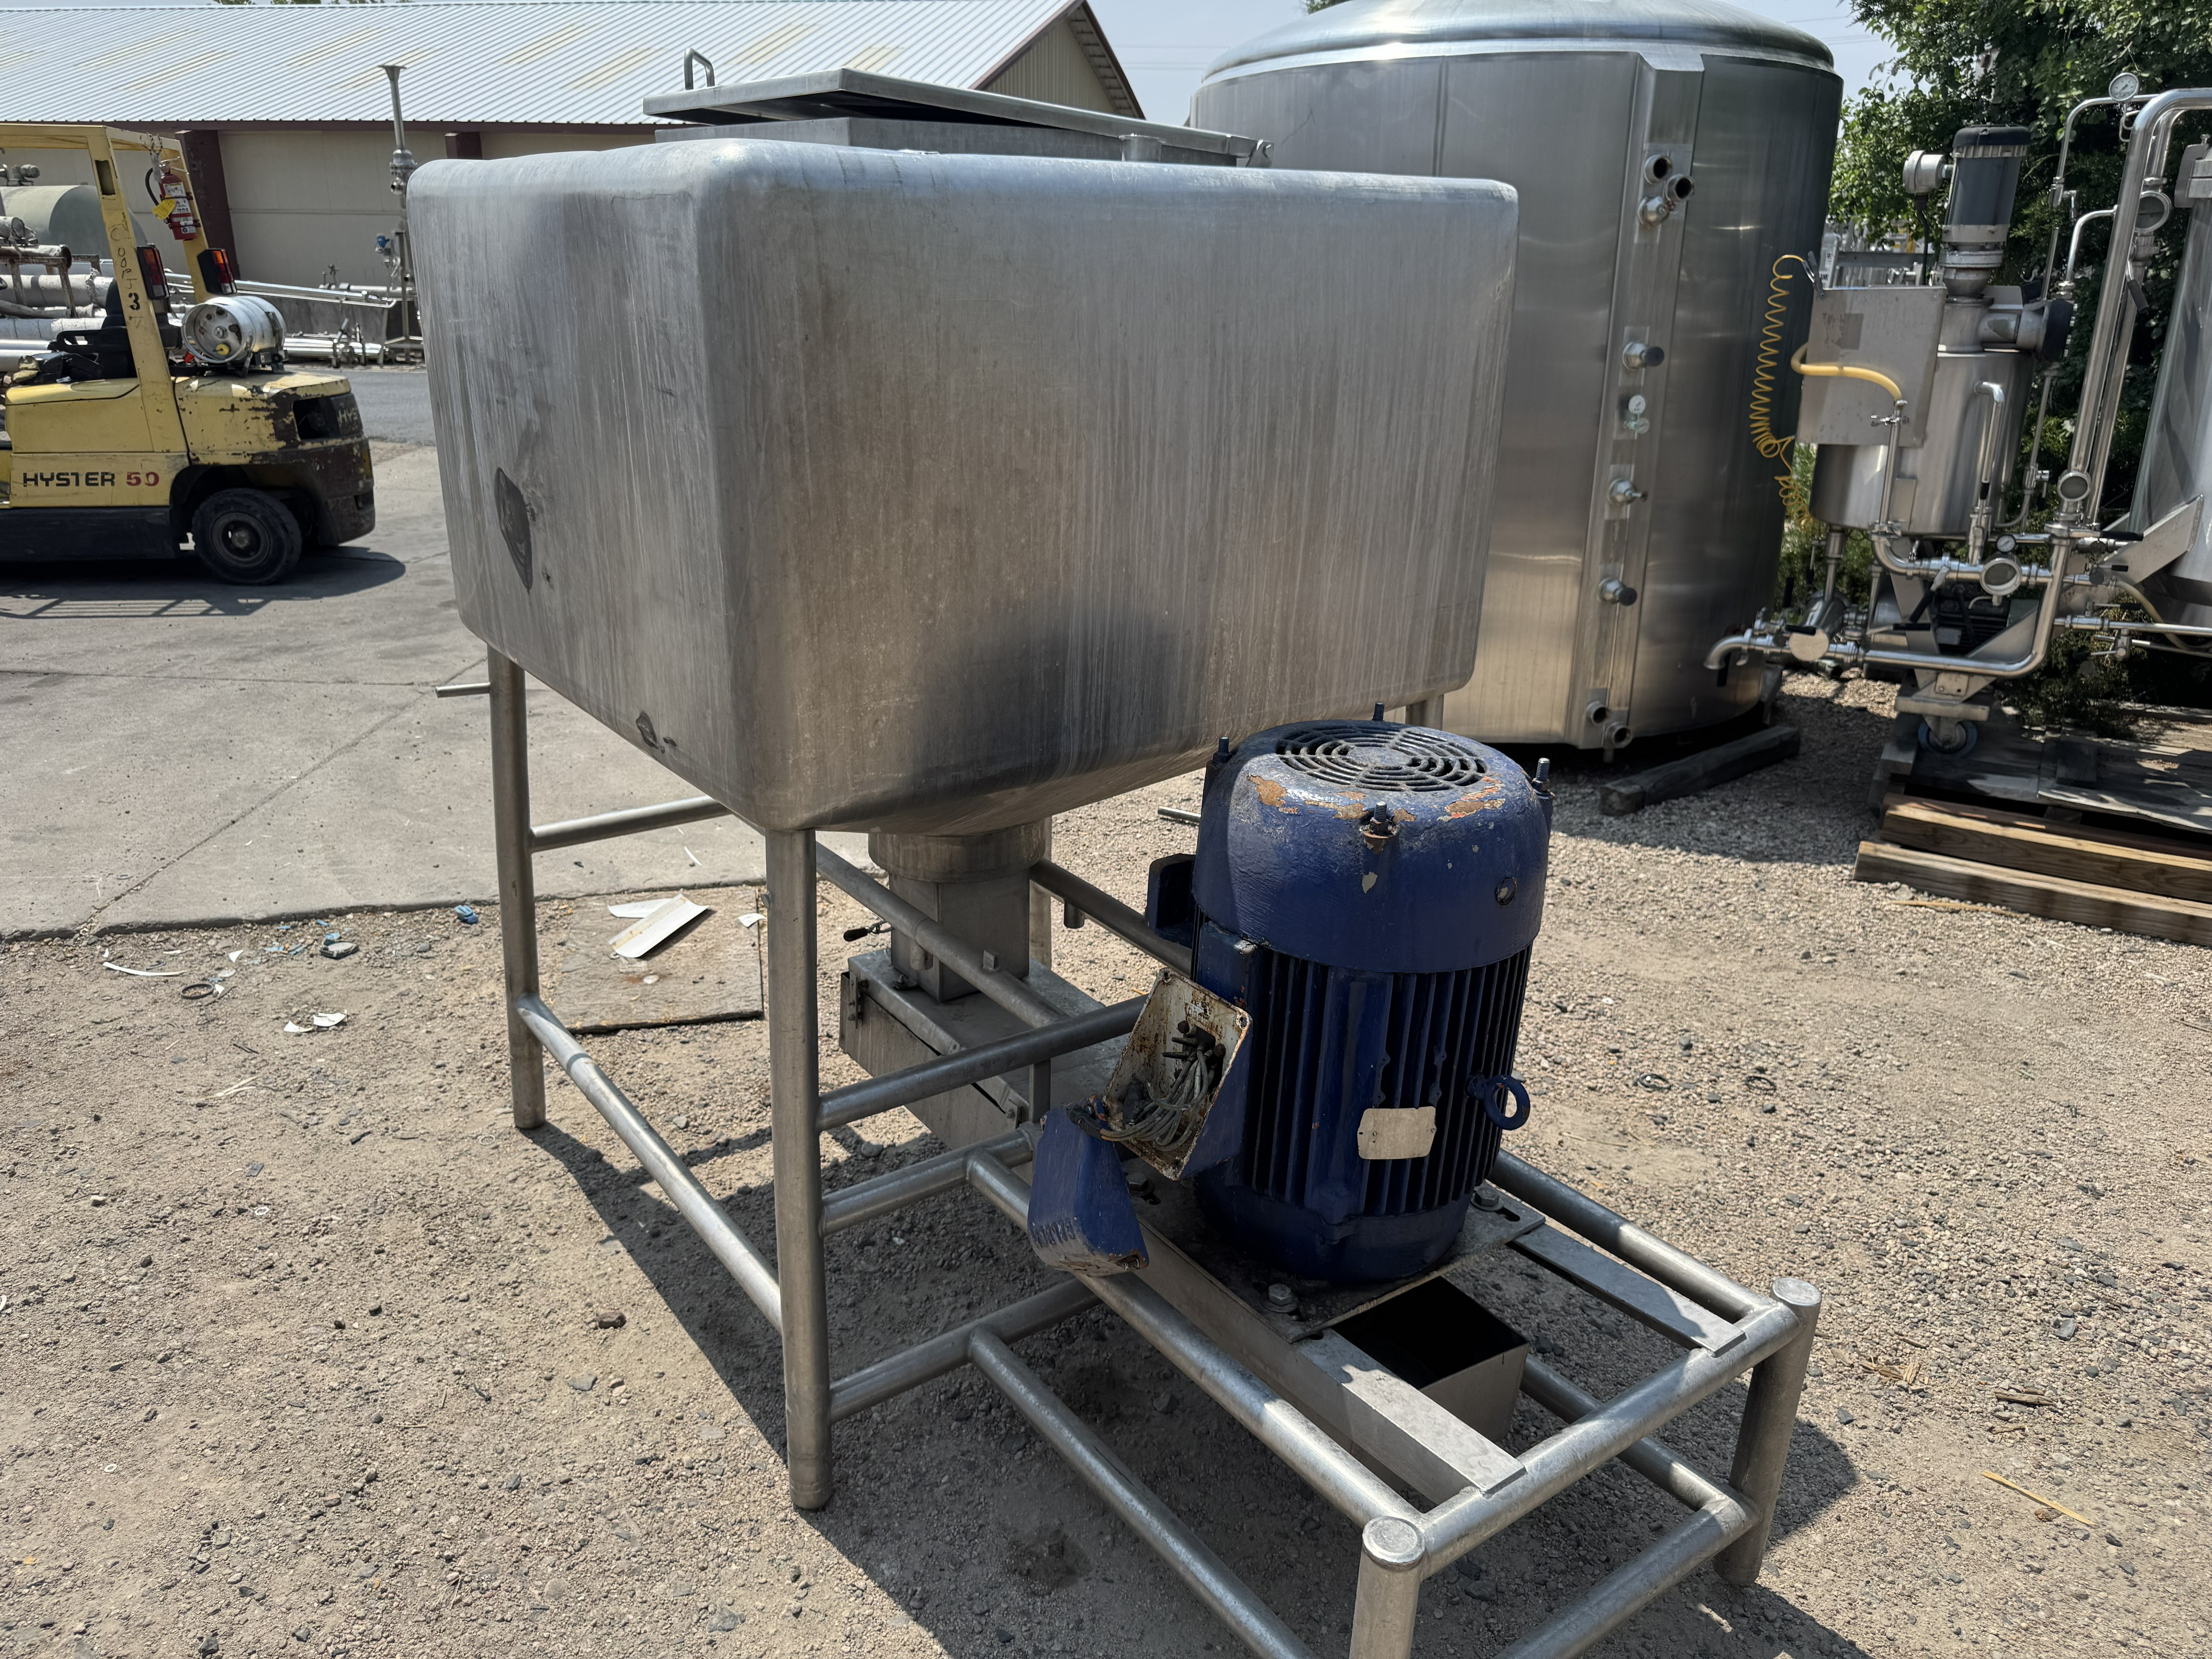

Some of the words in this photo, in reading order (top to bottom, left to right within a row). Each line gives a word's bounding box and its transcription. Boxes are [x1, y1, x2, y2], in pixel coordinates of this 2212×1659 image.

[129, 292, 140, 311] 3
[23, 472, 115, 487] HYSTER
[126, 472, 159, 486] 50
